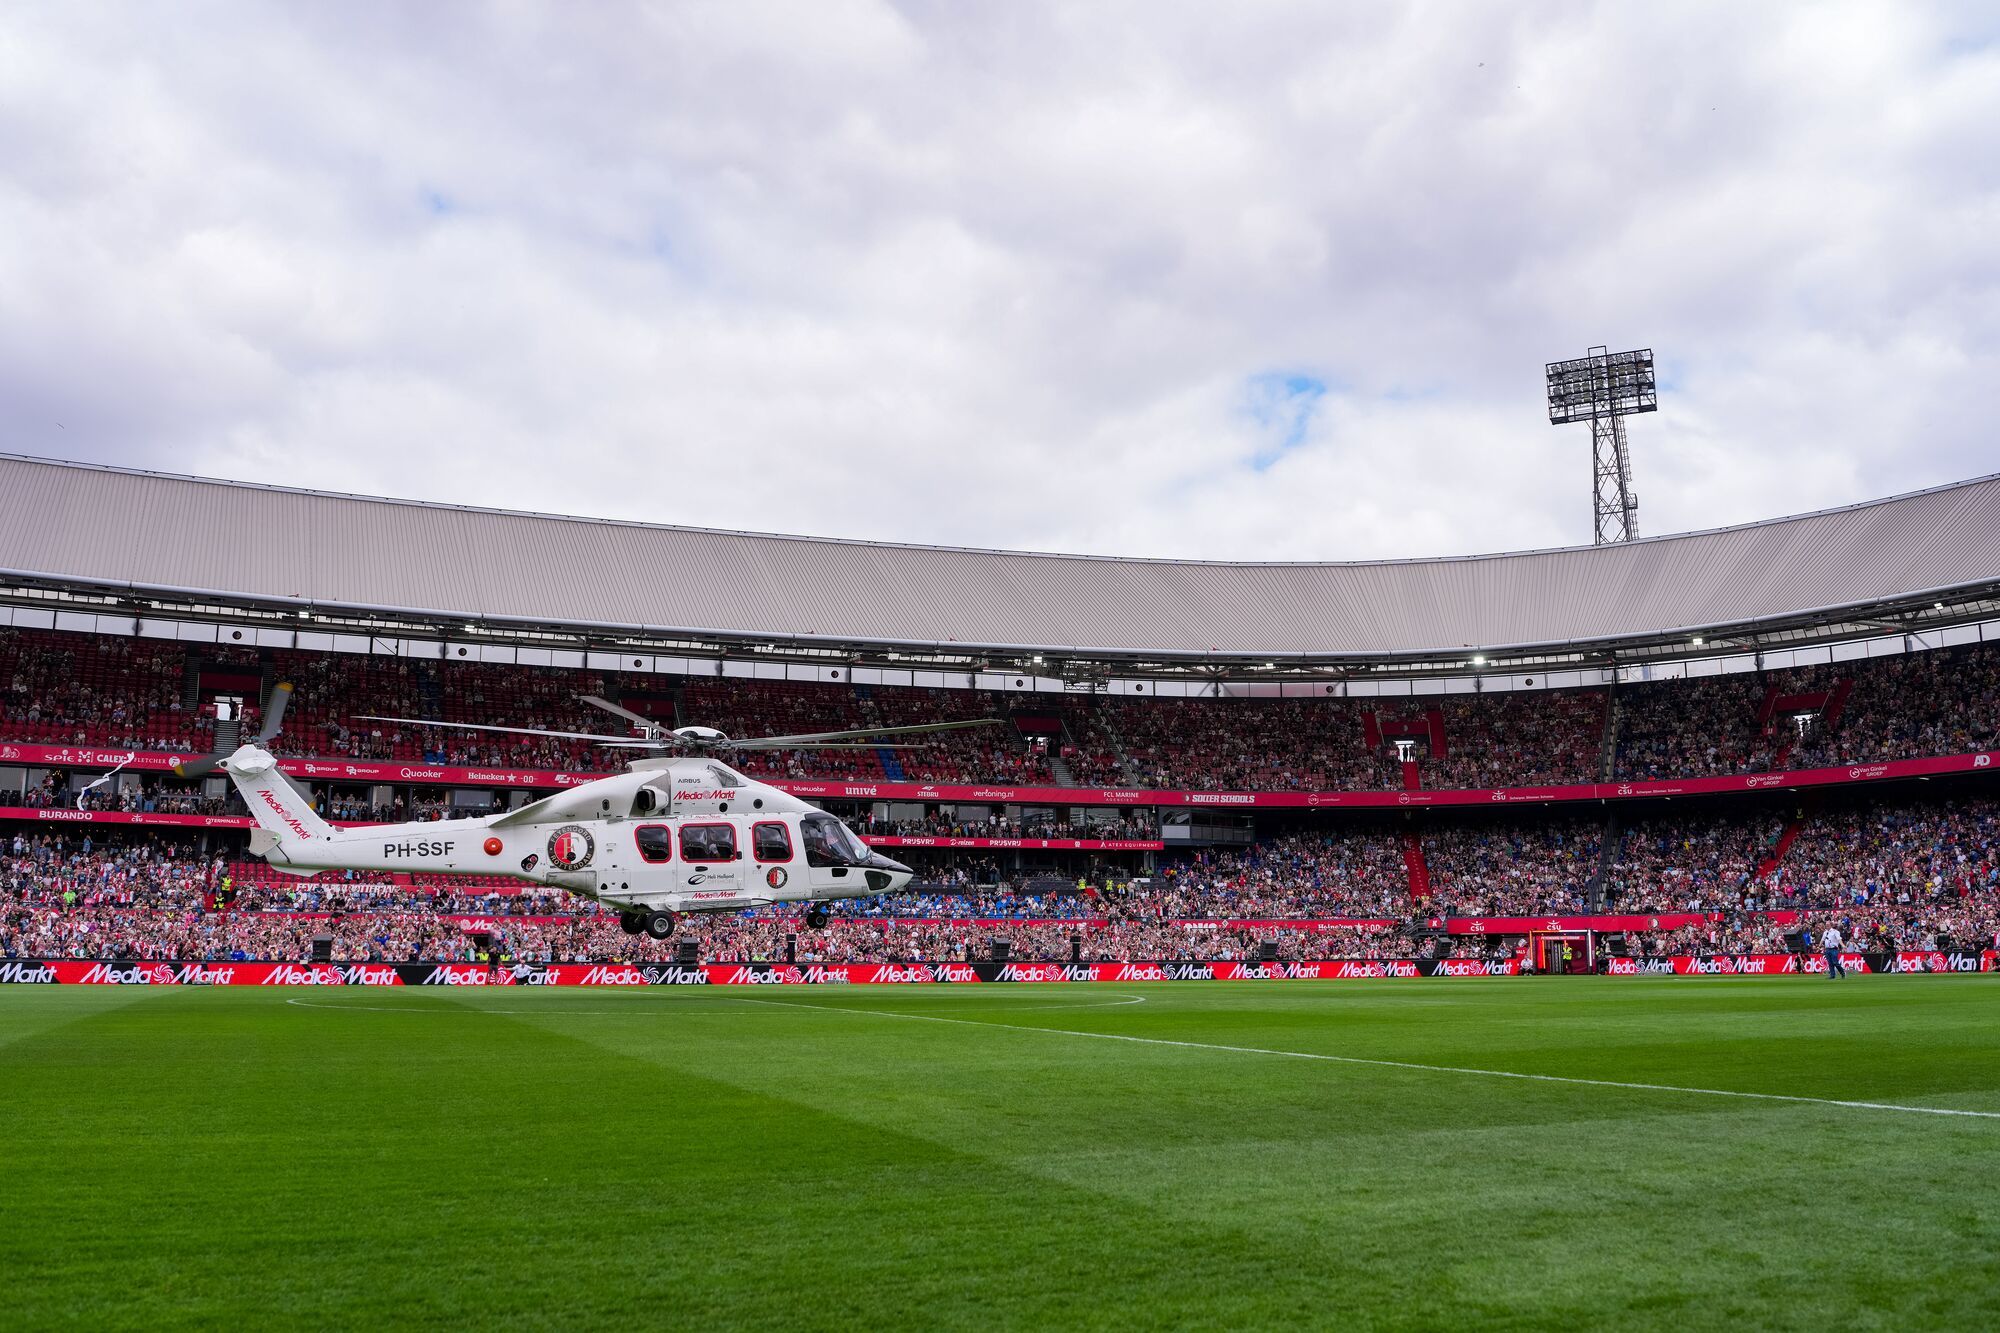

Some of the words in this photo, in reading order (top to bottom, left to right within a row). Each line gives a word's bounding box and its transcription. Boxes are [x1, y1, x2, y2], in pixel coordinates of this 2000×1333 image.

[1974, 755, 1990, 767] AD
[401, 768, 442, 778] Quooker
[468, 772, 505, 781] Heineken
[674, 790, 703, 800] Media
[710, 790, 736, 800] Markt
[845, 785, 876, 796] univé
[1220, 795, 1255, 803] SCHOOLS
[39, 810, 93, 820] BURANDO
[257, 789, 284, 815] Media
[285, 819, 312, 840] Markt
[550, 826, 592, 842] FEYENOORD
[384, 841, 454, 858] PH-SSF
[550, 853, 592, 870] ROTTERDAM
[1228, 962, 1271, 979] Media
[1282, 963, 1320, 978] Markt
[1336, 962, 1376, 978] Media
[1384, 962, 1416, 977] Markt
[1432, 960, 1470, 976] Media
[1480, 960, 1513, 976] Markt
[1686, 958, 1722, 974] Media
[1732, 956, 1766, 973] Markt
[1782, 956, 1822, 973] Mdia
[1838, 956, 1866, 973] arkt
[1883, 953, 1923, 972] Medi
[1942, 953, 1986, 972] Mart
[80, 964, 152, 984] Media
[262, 966, 326, 984] Media
[342, 966, 397, 984] Markt
[422, 966, 488, 985] Media
[504, 968, 560, 985] arkt
[580, 966, 640, 985] Media
[658, 966, 710, 984] Markt
[728, 966, 784, 984] Media
[870, 965, 920, 982] Media
[932, 966, 975, 982] Markt
[995, 964, 1044, 981] Media
[1057, 965, 1100, 981] Markt
[1116, 965, 1162, 980] Media
[1174, 964, 1214, 980] Markt
